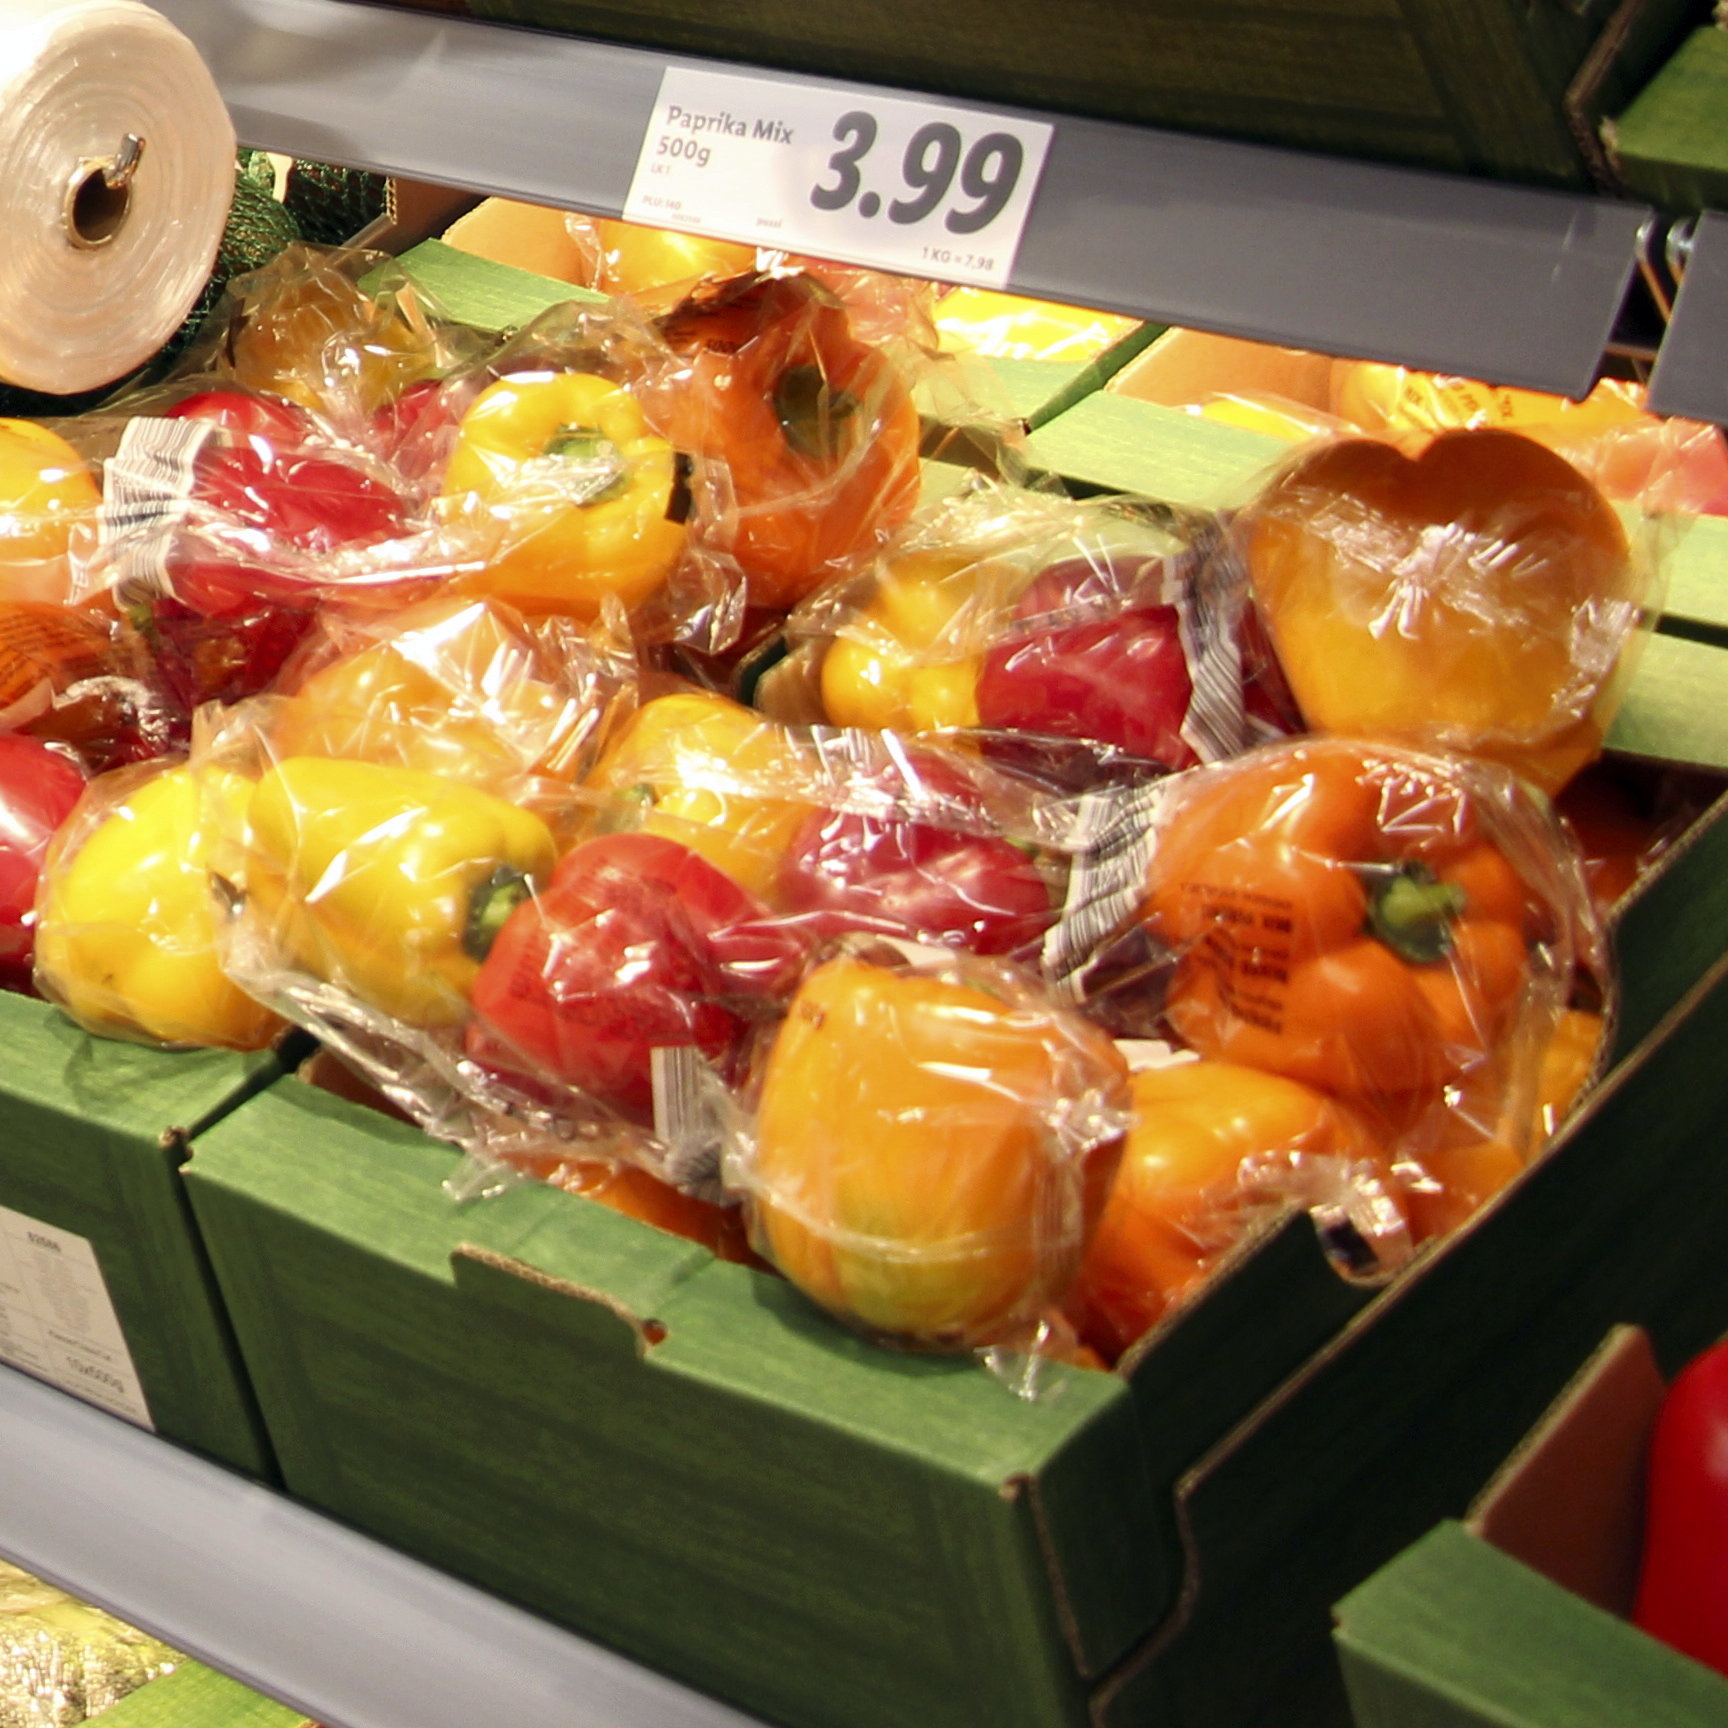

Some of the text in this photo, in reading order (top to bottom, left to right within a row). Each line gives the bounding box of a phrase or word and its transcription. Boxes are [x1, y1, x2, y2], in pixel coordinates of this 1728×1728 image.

[665, 105, 794, 145] Paprika Mix
[655, 135, 711, 167] 500g
[810, 110, 1024, 235] 3.99
[931, 247, 950, 265] KG
